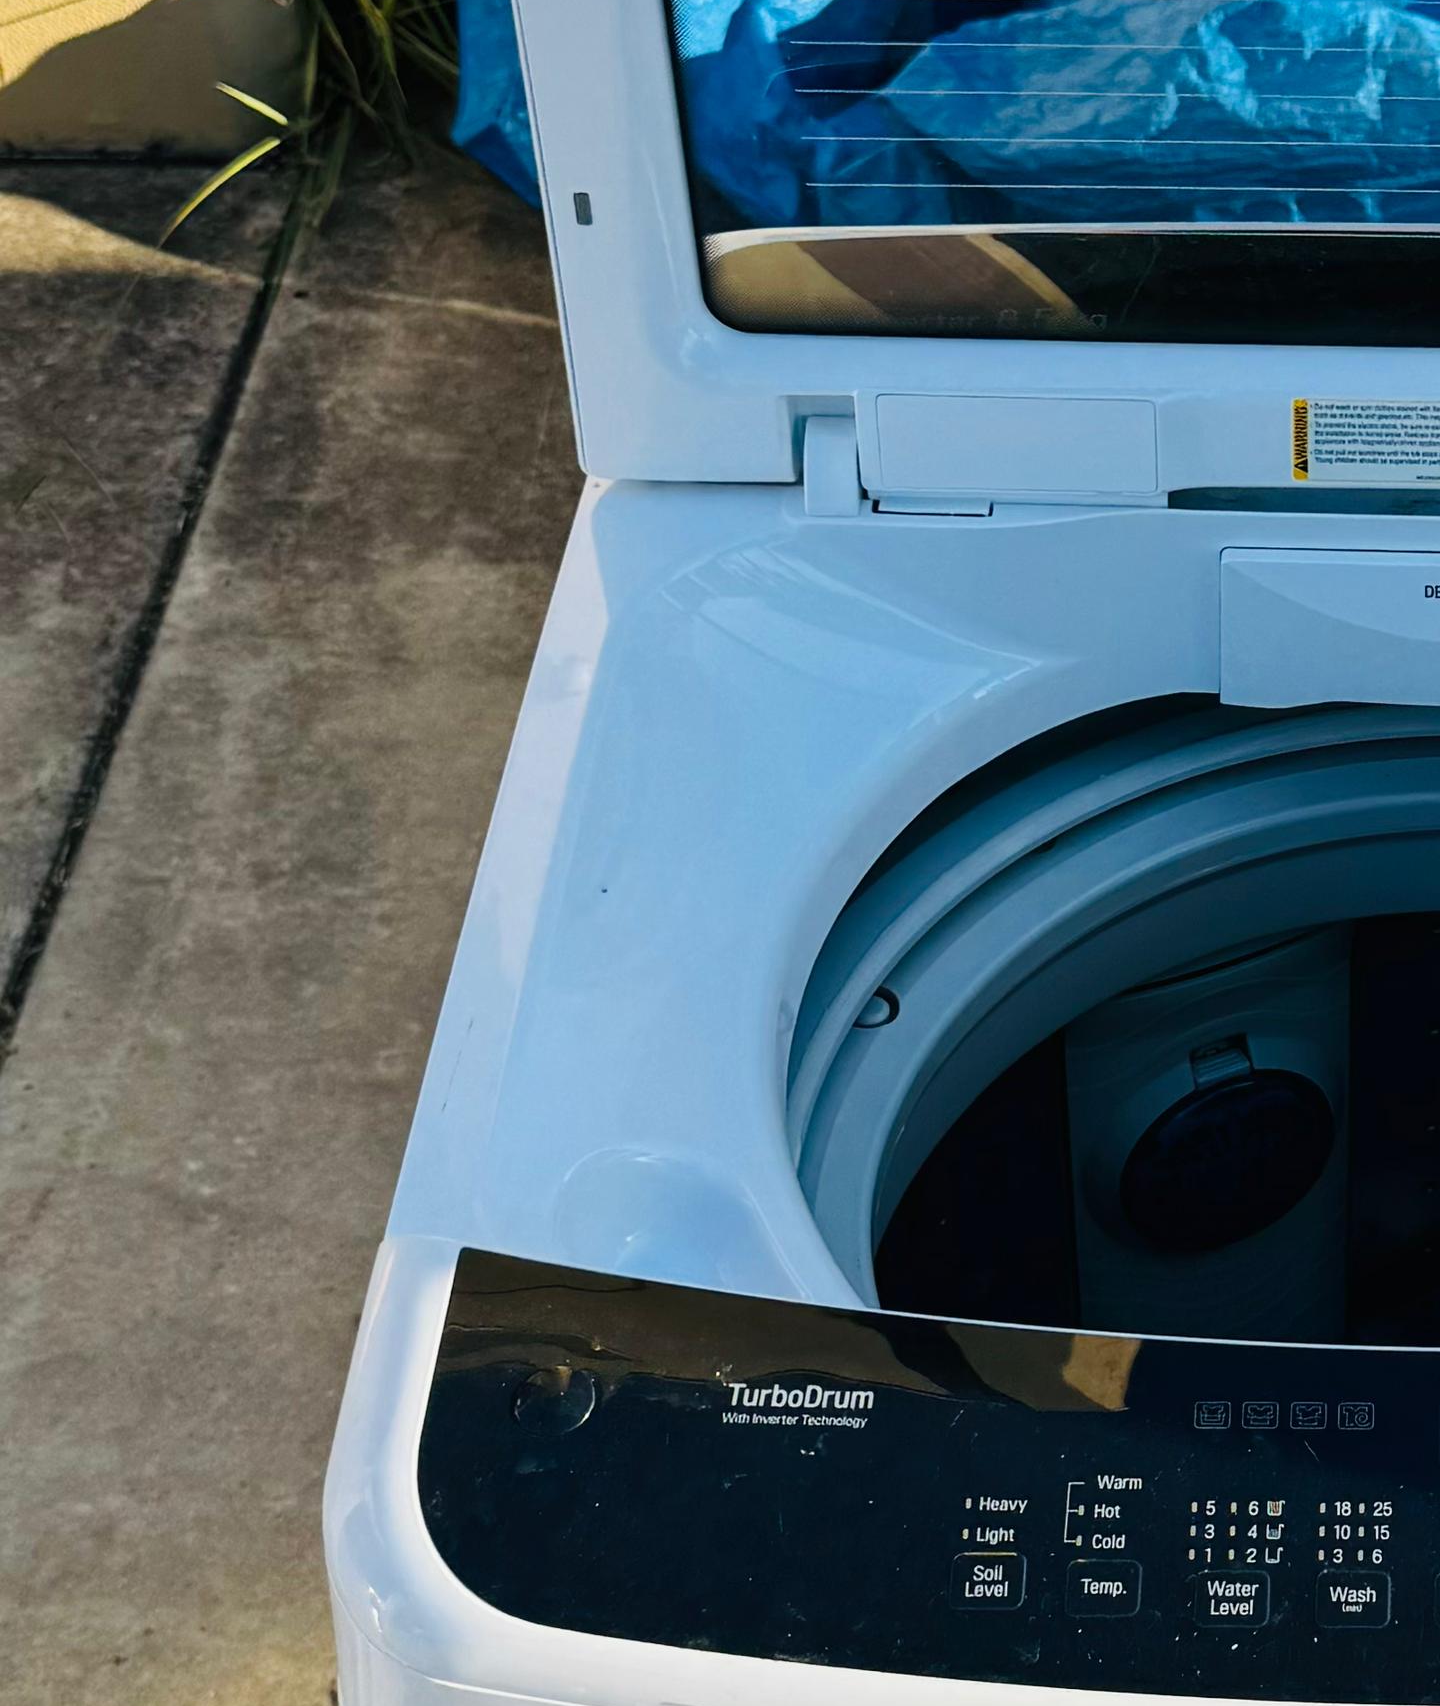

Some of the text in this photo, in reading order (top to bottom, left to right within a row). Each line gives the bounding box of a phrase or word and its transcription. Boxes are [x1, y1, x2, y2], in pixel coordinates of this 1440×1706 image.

[729, 1382, 875, 1410] TurboDrum
[722, 1412, 868, 1429] With Inverter Technology
[1097, 1474, 1143, 1490] Warm
[979, 1496, 1028, 1514] Heavy
[1093, 1503, 1121, 1519] Hot
[1205, 1499, 1259, 1516] 5 6
[1334, 1500, 1393, 1517] 18 25
[976, 1527, 1015, 1545] Light
[1204, 1524, 1258, 1540] 3 4
[1333, 1524, 1391, 1540] 10 15
[1092, 1533, 1126, 1549] Cold
[1205, 1548, 1257, 1563] 1 2
[1332, 1548, 1383, 1564] 3 6
[972, 1564, 1003, 1582] Soil
[964, 1581, 1009, 1598] Level
[1080, 1577, 1128, 1598] Temp.
[1207, 1580, 1260, 1597] Water
[1329, 1585, 1377, 1603] Wash
[1210, 1598, 1254, 1616] Level
